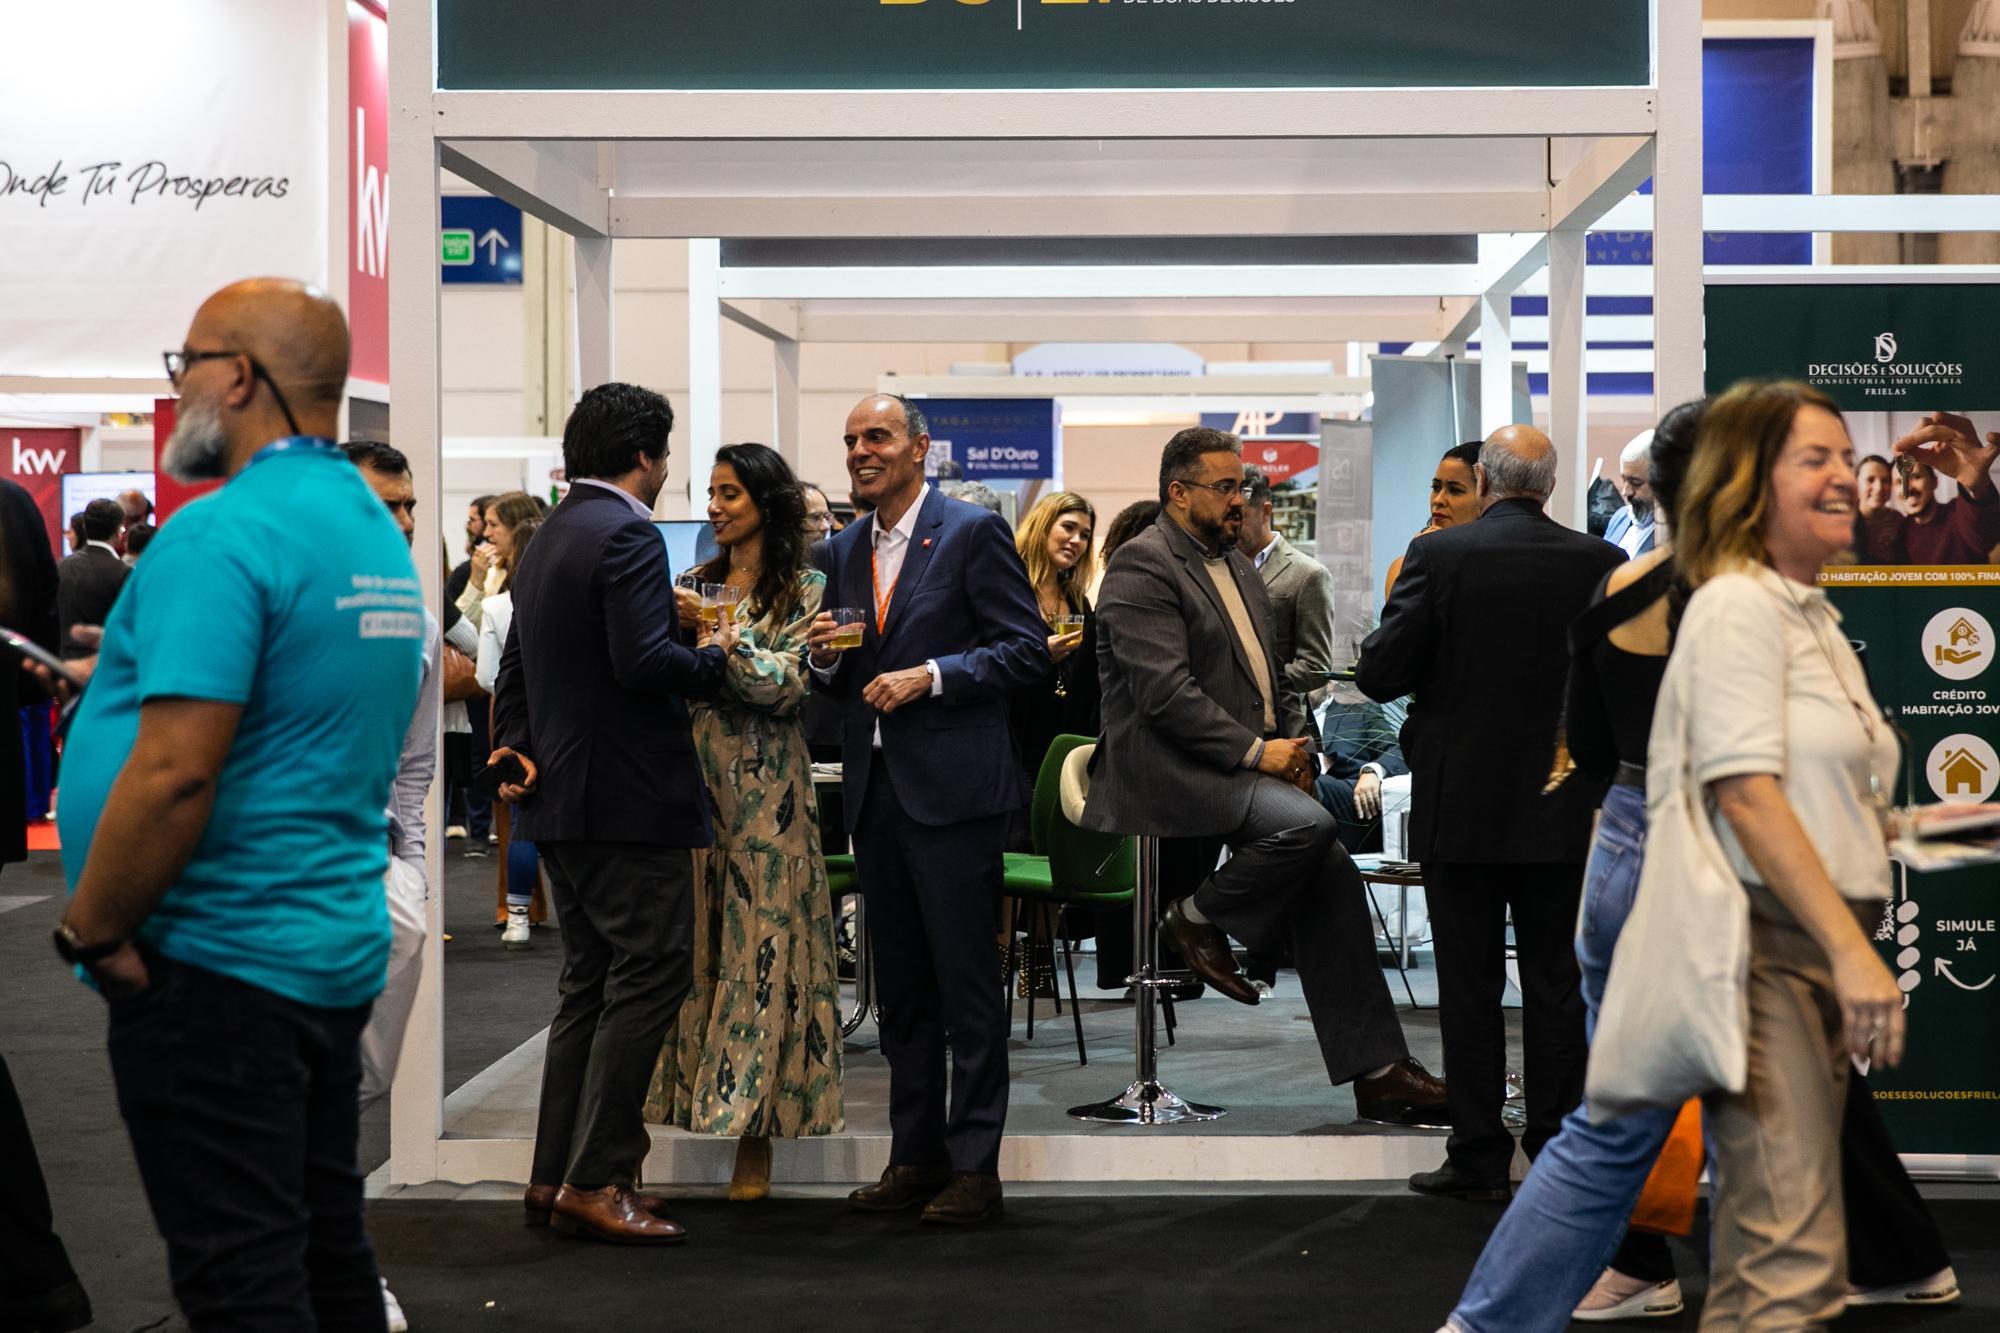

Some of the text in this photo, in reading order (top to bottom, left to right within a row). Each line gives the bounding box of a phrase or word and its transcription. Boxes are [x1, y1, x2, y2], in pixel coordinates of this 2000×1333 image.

[128, 161, 289, 211] Prosperas
[1808, 362, 1878, 376] DECISÕES
[1888, 362, 1962, 378] SOLUÇÕES
[1865, 388, 1907, 396] FRIELAS
[12, 437, 67, 475] kw
[1830, 571, 1887, 583] HABITAÇÃO
[1889, 572, 1922, 581] JOVEM
[1924, 572, 1947, 581] COM
[1950, 572, 1975, 581] 100%
[1932, 688, 1987, 700] CRÉDITO
[1902, 703, 1974, 717] HABITAÇÃO
[1936, 920, 1996, 932] SIMULE
[1956, 937, 1977, 951] JÁ
